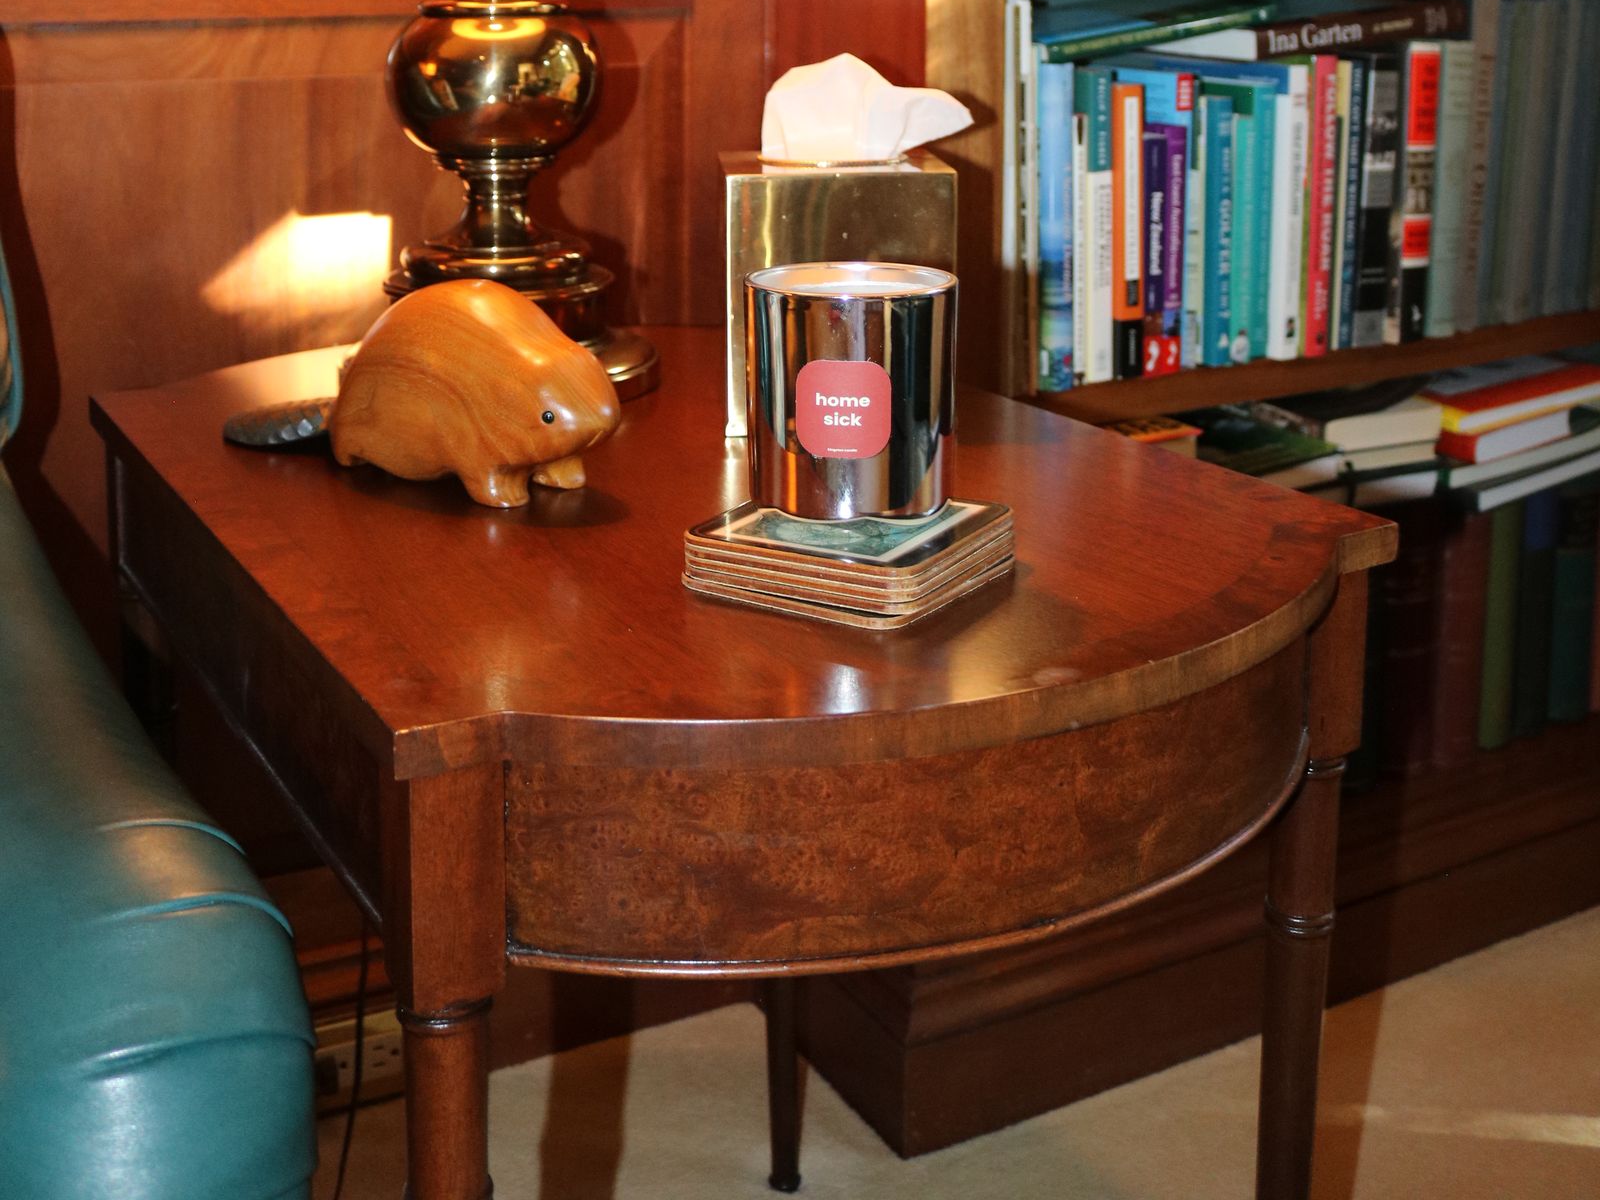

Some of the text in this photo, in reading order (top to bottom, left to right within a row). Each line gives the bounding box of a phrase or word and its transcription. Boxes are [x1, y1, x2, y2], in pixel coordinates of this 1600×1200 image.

[1267, 28, 1299, 54] Ina
[1301, 23, 1364, 49] Garten
[1169, 154, 1182, 177] East
[1319, 73, 1337, 272] FOLLOW THE ROAR
[1149, 191, 1163, 222] New
[1169, 178, 1181, 206] Coast
[1167, 206, 1181, 253] Australia
[1218, 198, 1232, 276] GOLFER
[1148, 222, 1163, 276] Zealand
[815, 392, 871, 407] home
[823, 412, 863, 427] sick
